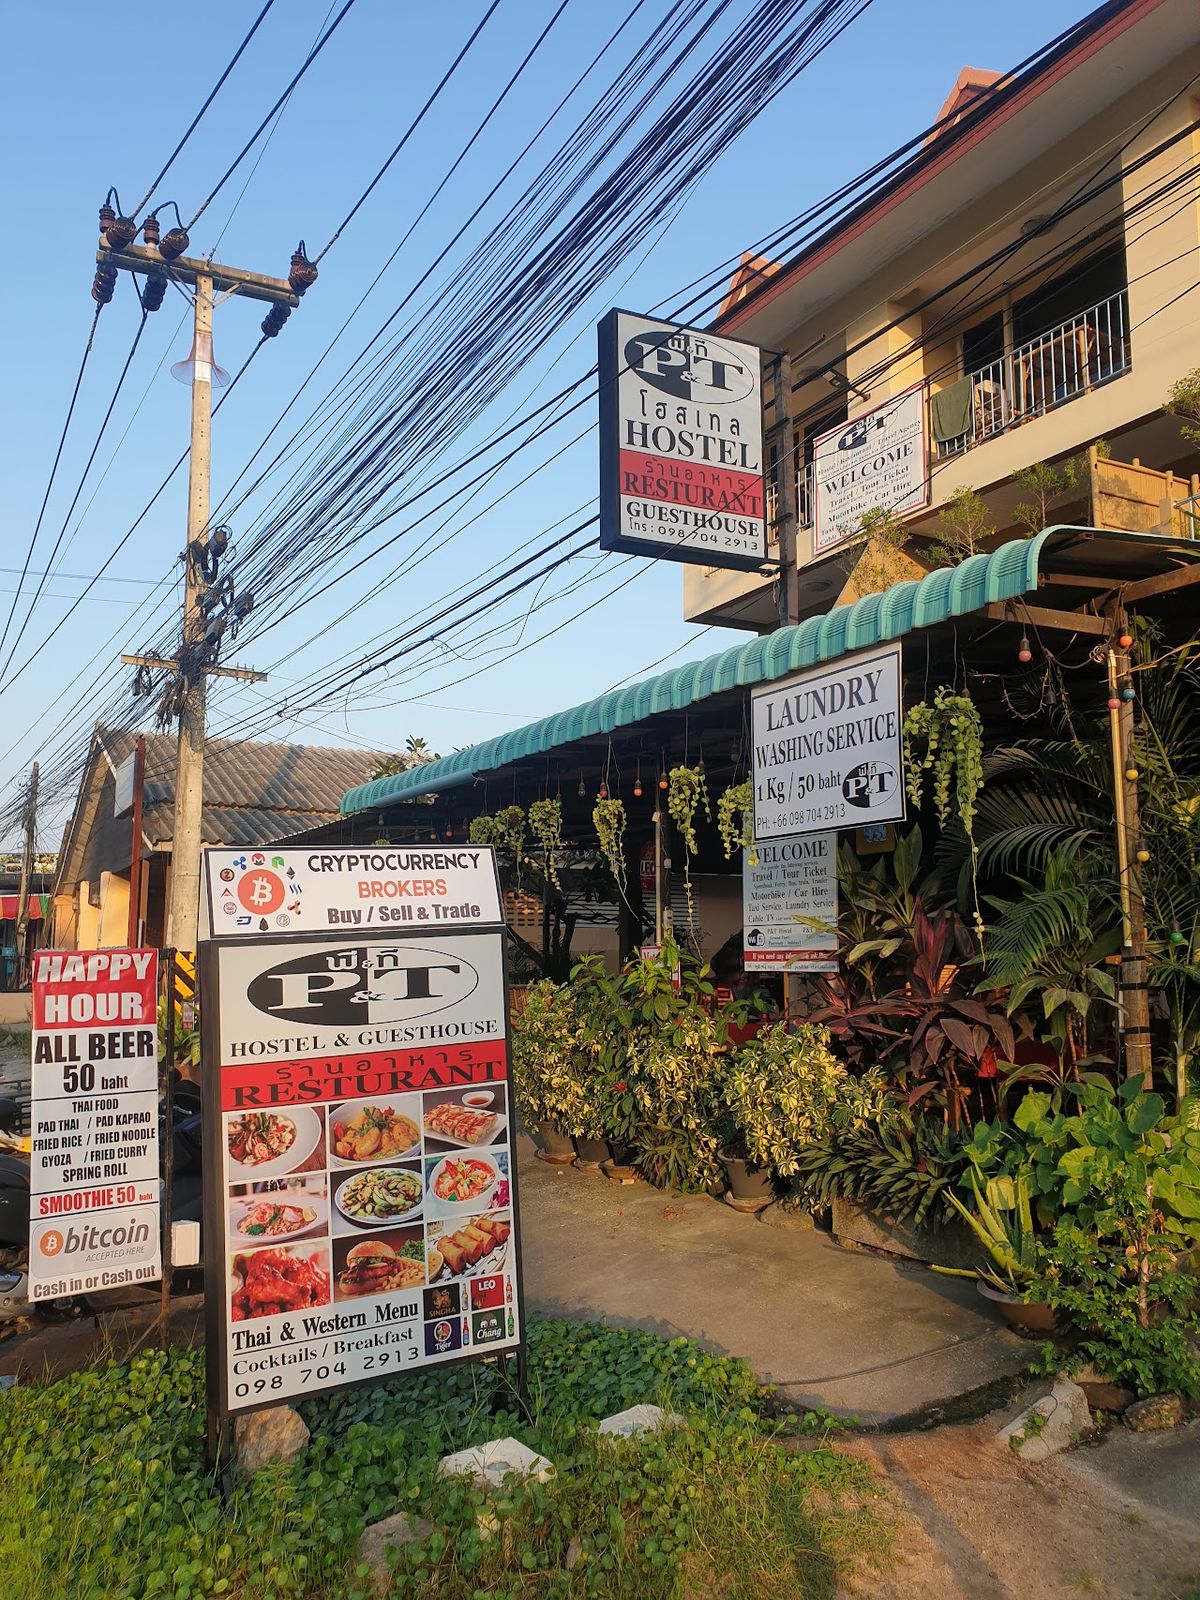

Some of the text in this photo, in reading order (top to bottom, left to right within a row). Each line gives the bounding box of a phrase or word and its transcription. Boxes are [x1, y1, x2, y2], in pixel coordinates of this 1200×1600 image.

[635, 341, 743, 391] P&T
[625, 418, 759, 470] HOSTEL
[825, 441, 913, 494] WELCOME
[624, 471, 761, 515] RESTURANT
[828, 501, 867, 522] Motorbike
[874, 490, 890, 501] Car
[893, 481, 911, 493] Hire
[830, 491, 854, 508] Travel
[861, 481, 879, 493] Tour
[883, 465, 909, 482] Ticket
[626, 501, 760, 537] GUESTHOUSE
[658, 526, 685, 538] 098
[691, 531, 718, 544] 704
[724, 537, 758, 550] 2913
[766, 669, 883, 732] LAUNDRY
[755, 711, 896, 769] WASHING SERVICE
[757, 770, 841, 804] 1 Kg / 50 baht
[845, 770, 893, 799] P&T
[757, 803, 846, 830] PH: +66 098 704 2913
[307, 853, 481, 873] CRYPTOCURRENCY
[752, 870, 773, 882] Travel
[782, 869, 799, 879] Tour
[803, 866, 827, 878] Ticket
[357, 879, 448, 898] BROKERS
[751, 890, 785, 900] Motorbike
[794, 888, 808, 897] Car
[811, 886, 828, 896] Hire
[812, 899, 834, 908] Service
[327, 903, 481, 924] Buy / Sell & Trade
[37, 953, 153, 983] HAPPY
[267, 964, 461, 1010] P&T
[44, 992, 143, 1024] HOUR
[34, 1030, 154, 1064] ALL BEER
[230, 1019, 498, 1057] HOSTEL & GUESTHOUSE
[63, 1064, 128, 1093] 50 baht
[231, 1060, 502, 1107] RESTURANT
[72, 1098, 119, 1113] THAI FOOD
[38, 1121, 56, 1134] PAD
[58, 1119, 79, 1132] THAI
[96, 1115, 114, 1128] PAD
[115, 1111, 151, 1126] KAPRAO
[33, 1138, 59, 1151] FRIED
[61, 1135, 83, 1148] RICE
[95, 1131, 120, 1145] FRIED
[122, 1127, 156, 1142] NOODLE
[41, 1154, 72, 1168] GYOZA
[90, 1149, 115, 1163] FRIED
[117, 1145, 148, 1158] CURRY
[63, 1162, 128, 1183] SPRING ROLL
[39, 1185, 153, 1215] SMOOTHIE 50 baht
[64, 1218, 149, 1254] bitcoin
[85, 1245, 146, 1263] ACCEPTED HERE
[34, 1264, 156, 1298] Cash in or Cash out
[478, 1279, 496, 1291] LEO
[232, 1302, 419, 1351] Thai & Western Menu
[429, 1307, 456, 1318] SINGHA
[435, 1341, 452, 1352] Tiger
[477, 1327, 502, 1340] Chang
[233, 1327, 415, 1375] Cocktails / Breakfast
[235, 1347, 419, 1397] 098 704 2913
